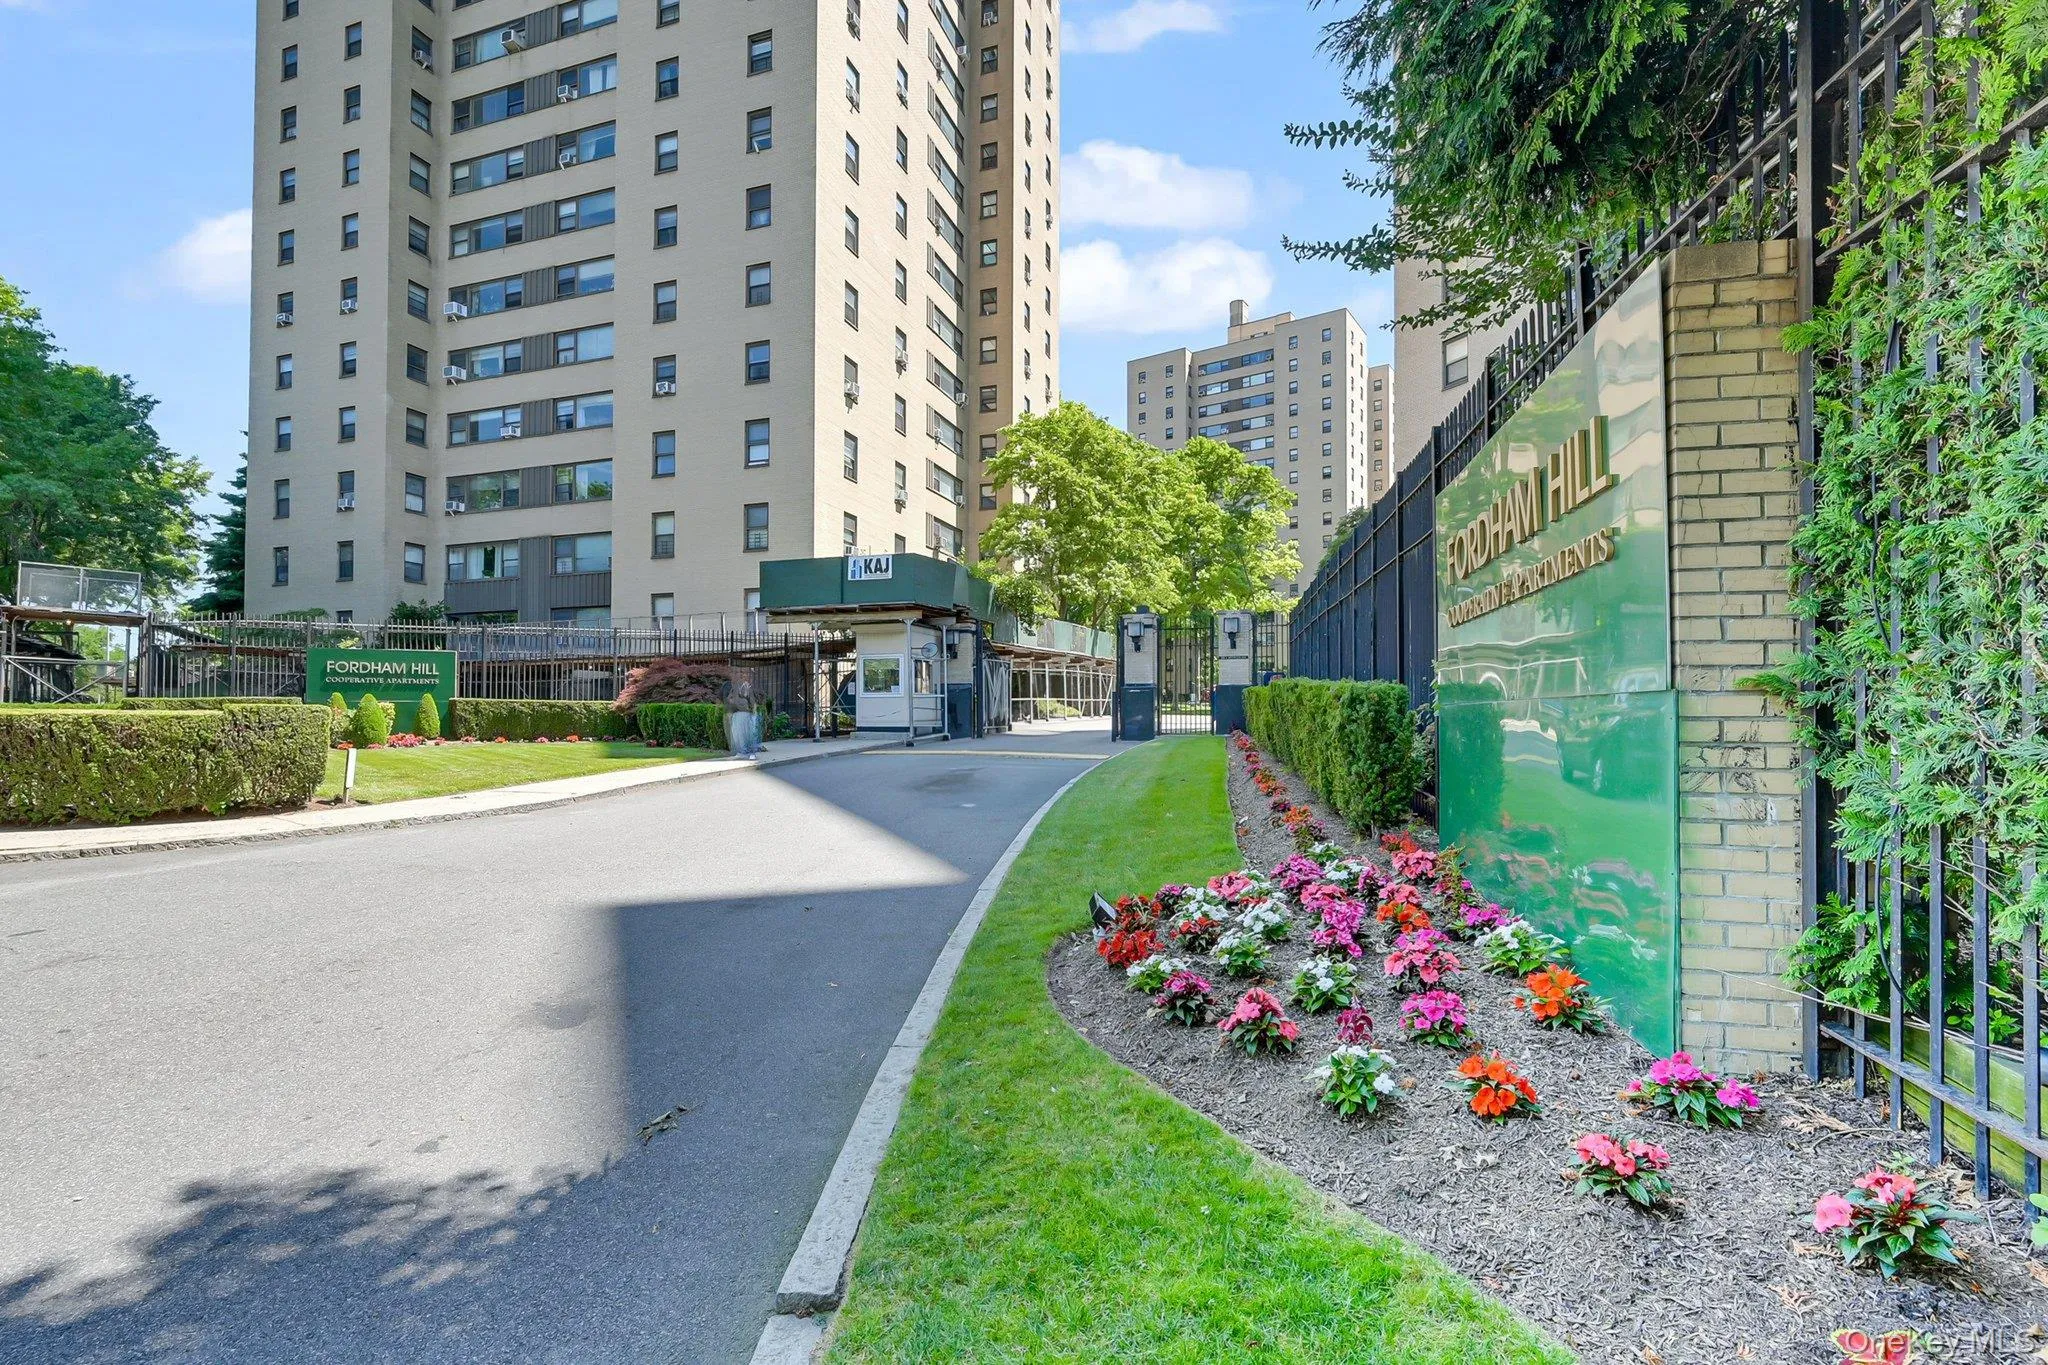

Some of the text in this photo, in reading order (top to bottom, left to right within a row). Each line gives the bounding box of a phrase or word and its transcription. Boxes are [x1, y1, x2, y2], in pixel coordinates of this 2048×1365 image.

[1447, 415, 1613, 585] FORDHAM HILL
[864, 557, 890, 574] KAJ
[1510, 526, 1616, 600] APARTMENTS
[326, 660, 440, 675] FORDHAM HILL
[325, 676, 440, 685] COOPERATIVE APARTMENTS
